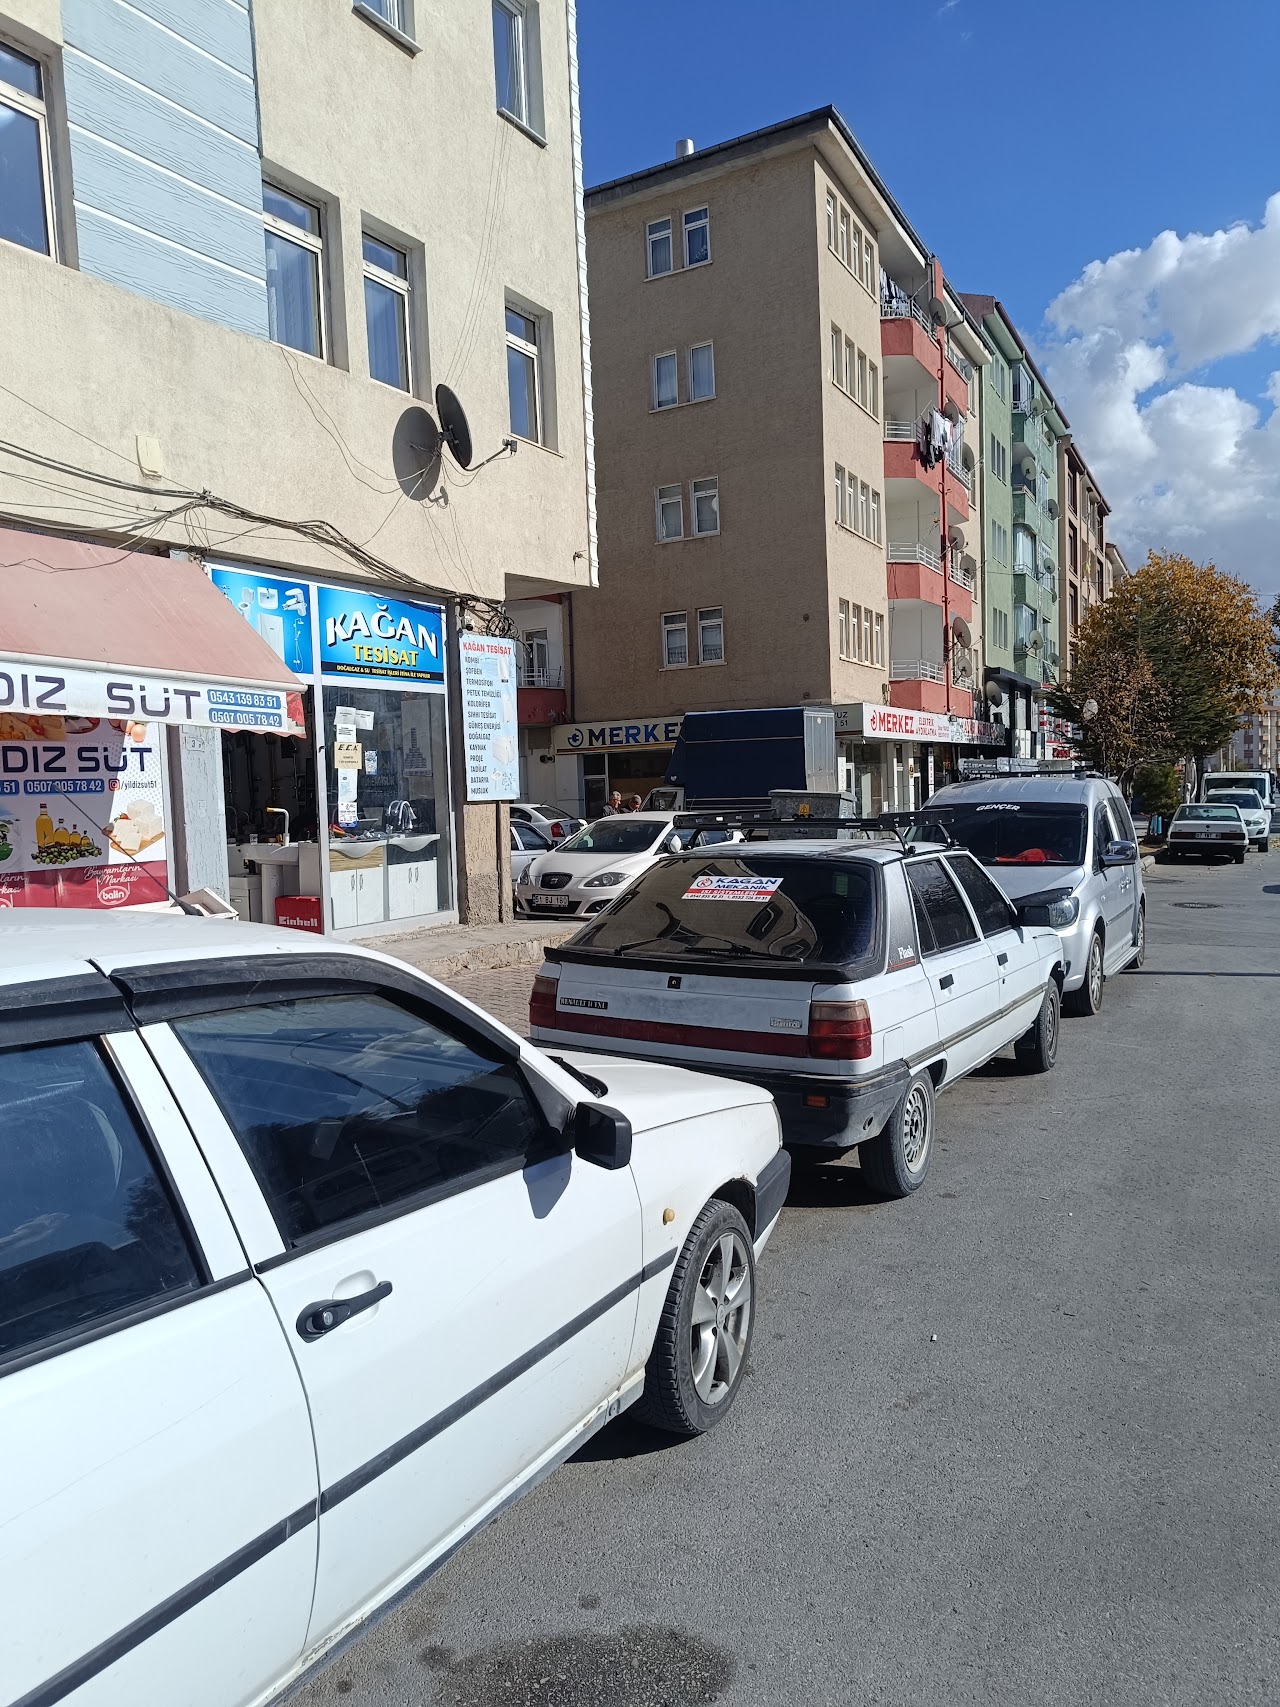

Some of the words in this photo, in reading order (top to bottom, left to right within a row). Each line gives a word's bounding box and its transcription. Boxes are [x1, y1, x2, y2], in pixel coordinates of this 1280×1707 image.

[326, 603, 438, 659] KAĞAN
[463, 641, 485, 652] KAĞAN
[486, 643, 512, 655] TESİSAT
[352, 644, 419, 666] TESİSAT
[336, 664, 360, 673] DOĞALGAZ
[465, 667, 483, 676] ŞOFBEN
[466, 677, 494, 687] TERMOSİFON
[210, 690, 236, 704] 0543
[236, 691, 253, 705] 139
[253, 693, 266, 707] 83
[266, 694, 278, 708] 51
[466, 689, 481, 697] PETEK
[107, 682, 201, 720] SÜT
[211, 710, 236, 724] 0507
[236, 711, 255, 725] 005
[255, 713, 268, 726] 78
[268, 714, 280, 727] 42
[878, 711, 915, 734] MERKEZ
[468, 720, 484, 730] GÜNEŞ
[468, 731, 491, 740] DOĞALGAZ
[587, 722, 682, 747] MERKE
[77, 747, 152, 773] SÜT
[469, 754, 484, 763] PROJE
[470, 764, 487, 773] TADİLAT
[3, 781, 16, 793] 51
[27, 781, 51, 793] 0507
[75, 780, 88, 792] 78
[88, 780, 102, 792] 42
[470, 787, 489, 795] MUSLUK
[278, 915, 318, 927] Einhell
[560, 997, 587, 1007] RENAULT
